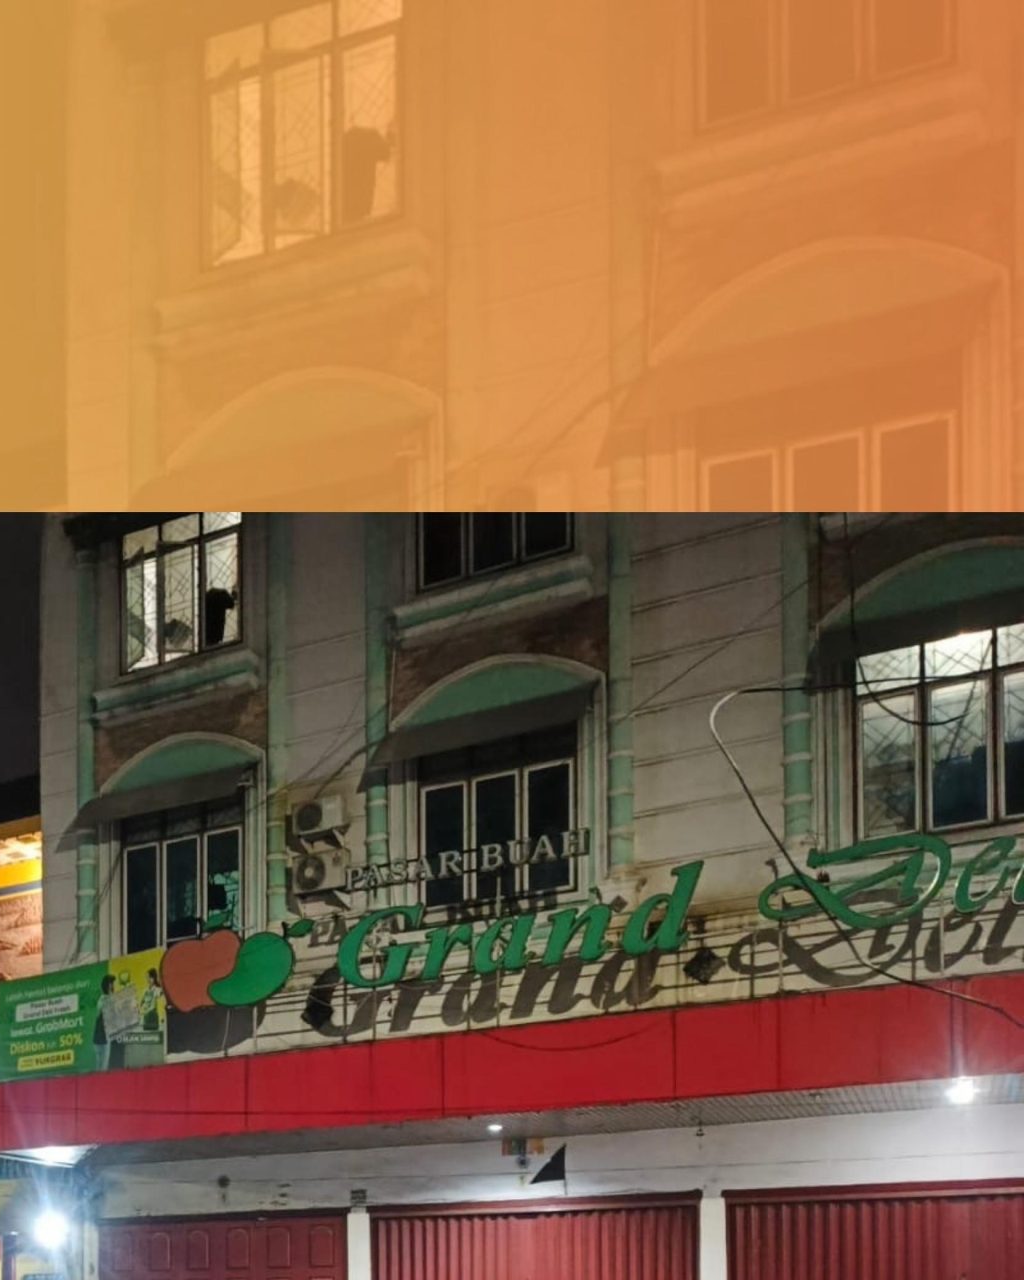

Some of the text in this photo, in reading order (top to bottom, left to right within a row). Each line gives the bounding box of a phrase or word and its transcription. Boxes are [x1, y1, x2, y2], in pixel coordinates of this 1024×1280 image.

[345, 827, 591, 892] PASAR BUAH
[337, 833, 1024, 988] Grand De
[10, 1041, 45, 1056] Diskon
[59, 1033, 83, 1047] 50%
[36, 1016, 83, 1034] GrabMart
